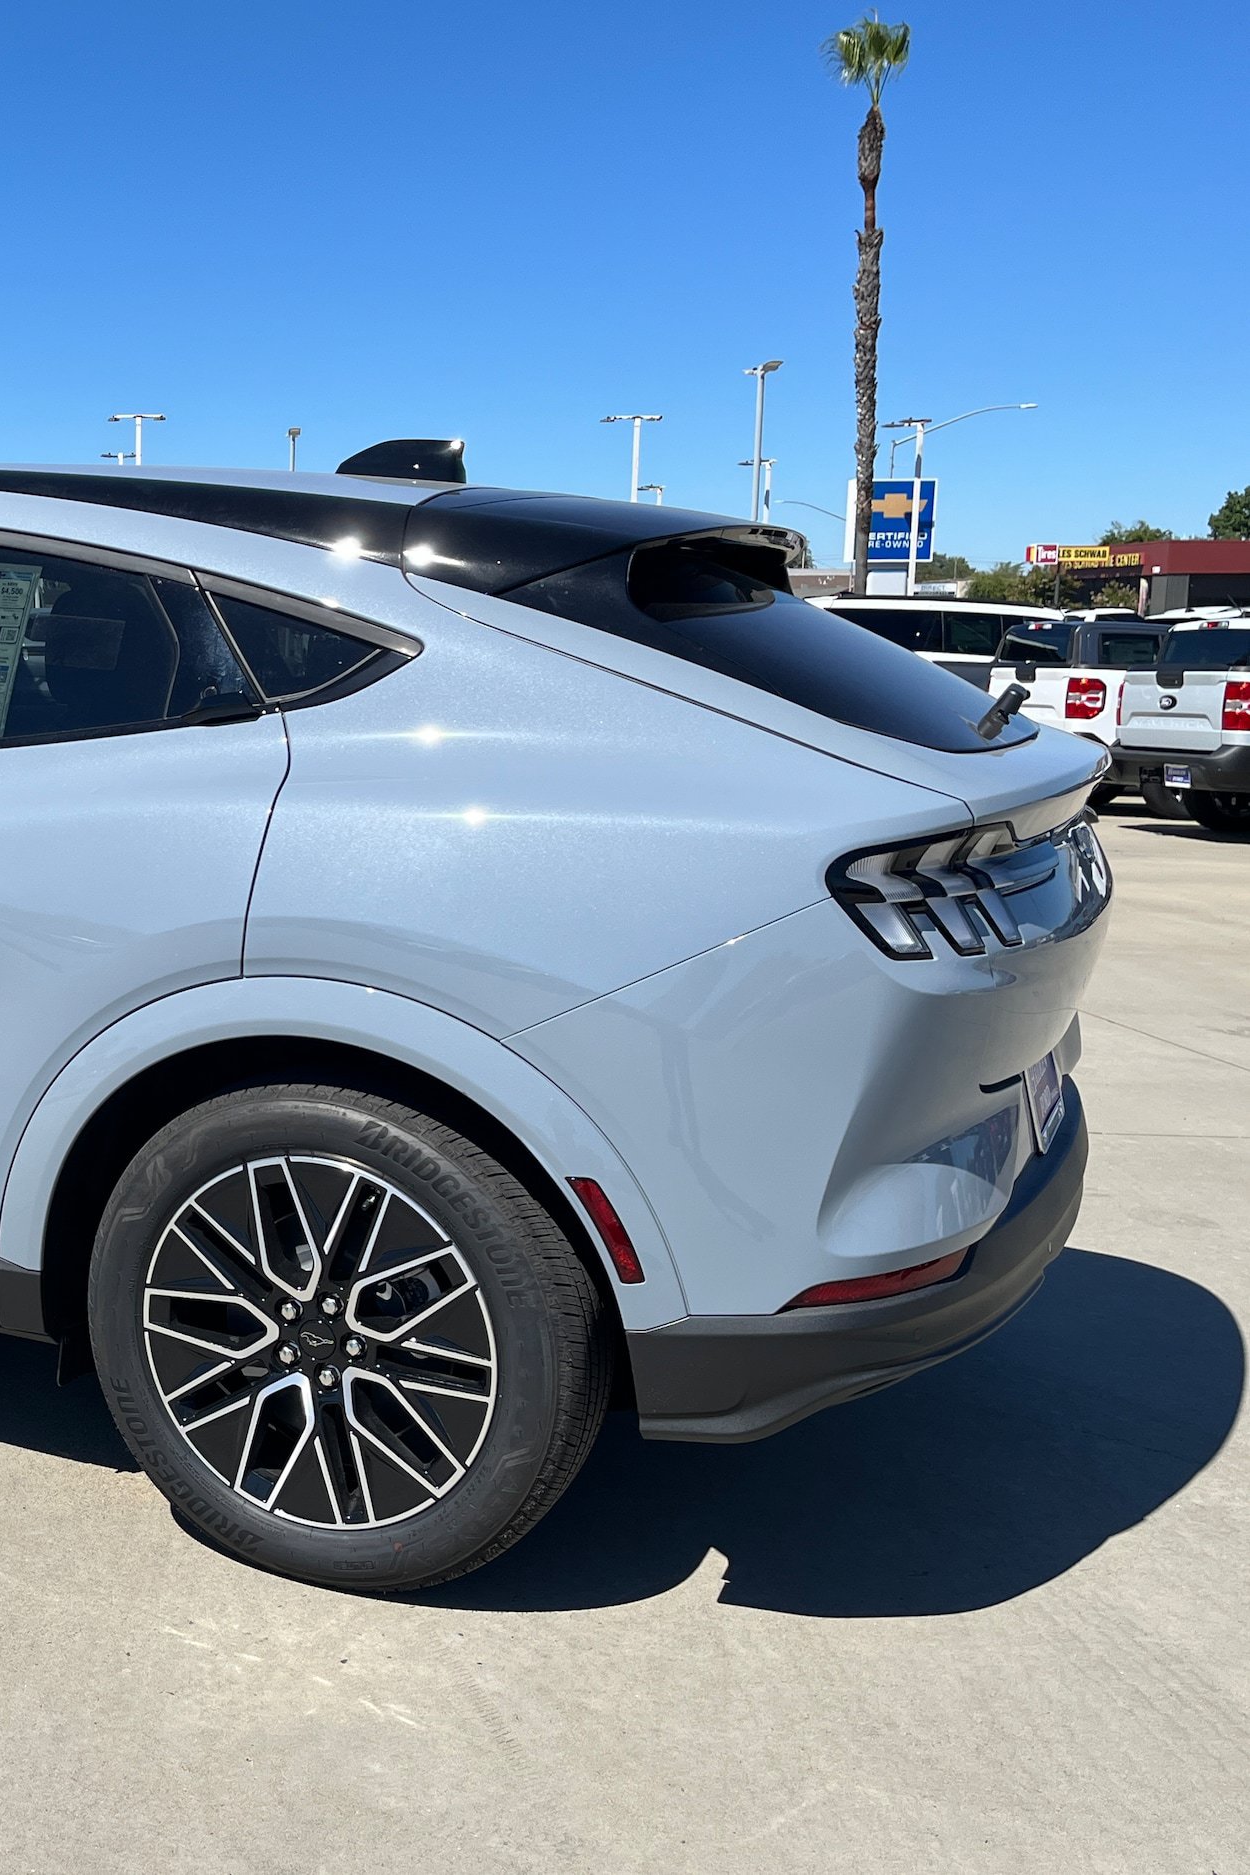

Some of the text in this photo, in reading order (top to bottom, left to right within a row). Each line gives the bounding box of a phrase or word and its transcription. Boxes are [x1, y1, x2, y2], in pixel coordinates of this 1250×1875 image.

[868, 532, 928, 540] ERTIFID
[868, 540, 924, 548] RE-OWND
[1037, 546, 1057, 562] Tires
[1074, 549, 1107, 559] SCHWAB
[1116, 553, 1140, 567] CENTER
[0, 587, 24, 595] $4,500
[353, 1120, 536, 1309] BRIDGESTONE
[111, 1376, 264, 1553] BRIDGESTONE
